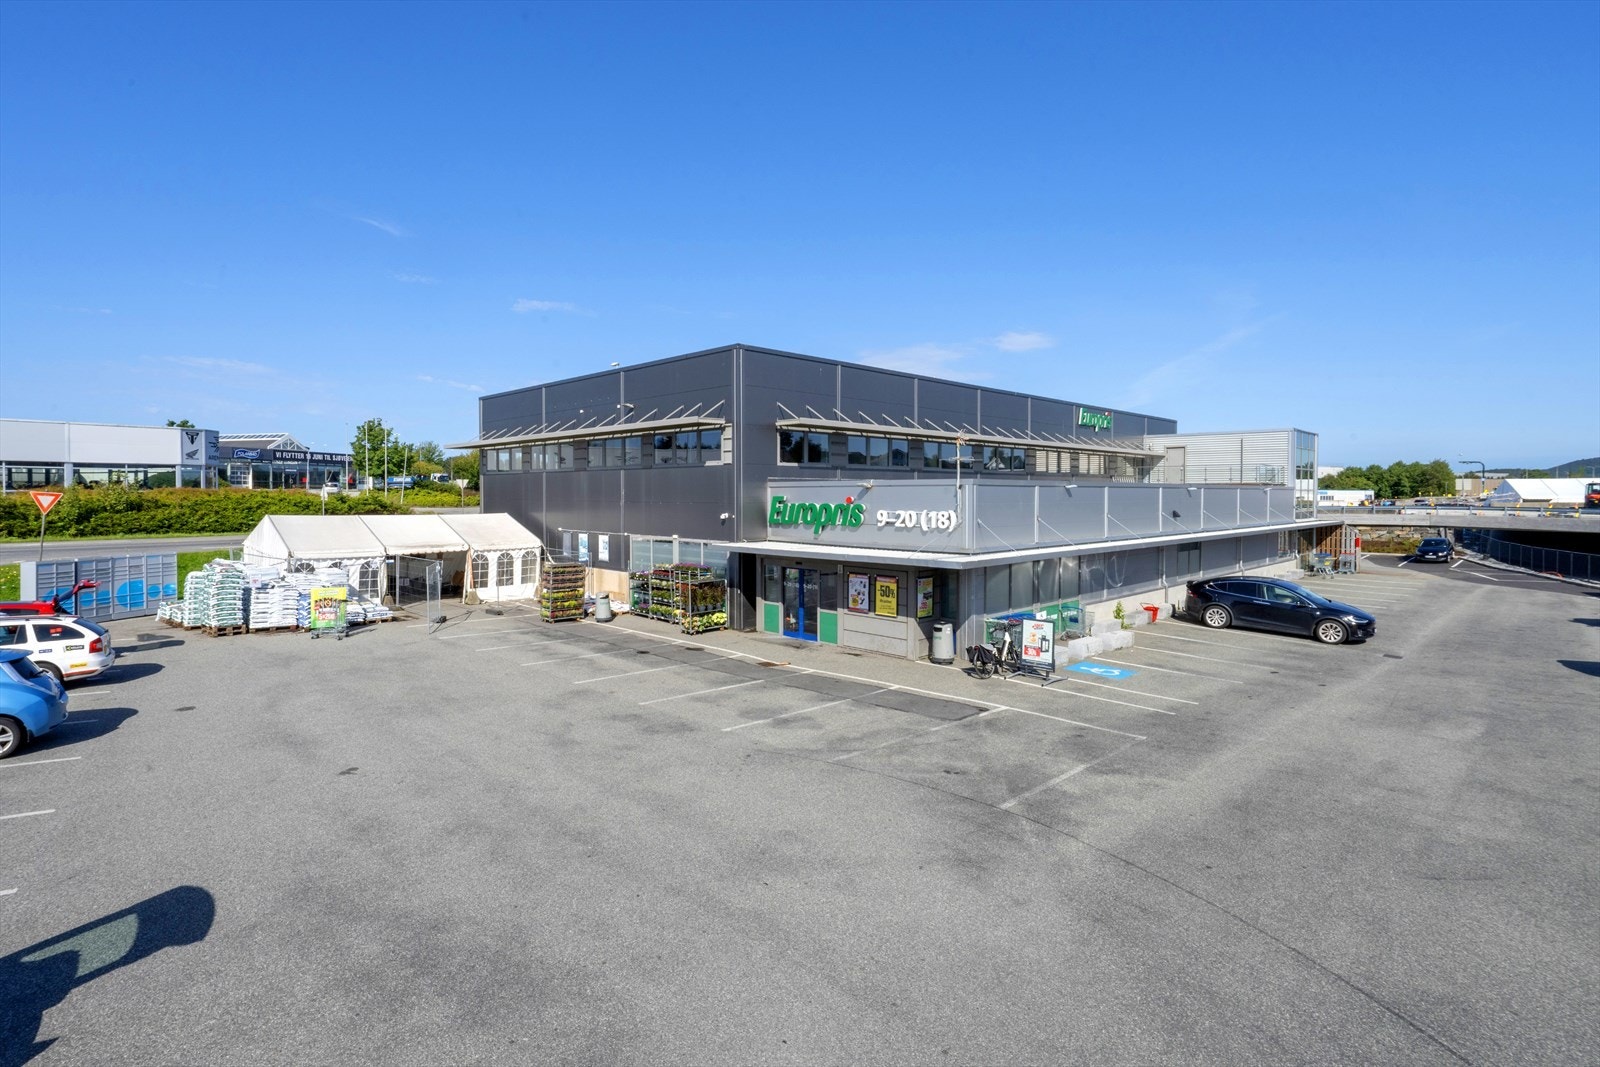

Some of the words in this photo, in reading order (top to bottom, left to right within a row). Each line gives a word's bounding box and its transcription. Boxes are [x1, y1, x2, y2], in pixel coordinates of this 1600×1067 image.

[1078, 407, 1112, 432] Europris
[282, 451, 305, 459] FLYTTER
[769, 496, 866, 535] Europris
[919, 510, 958, 532] (18)
